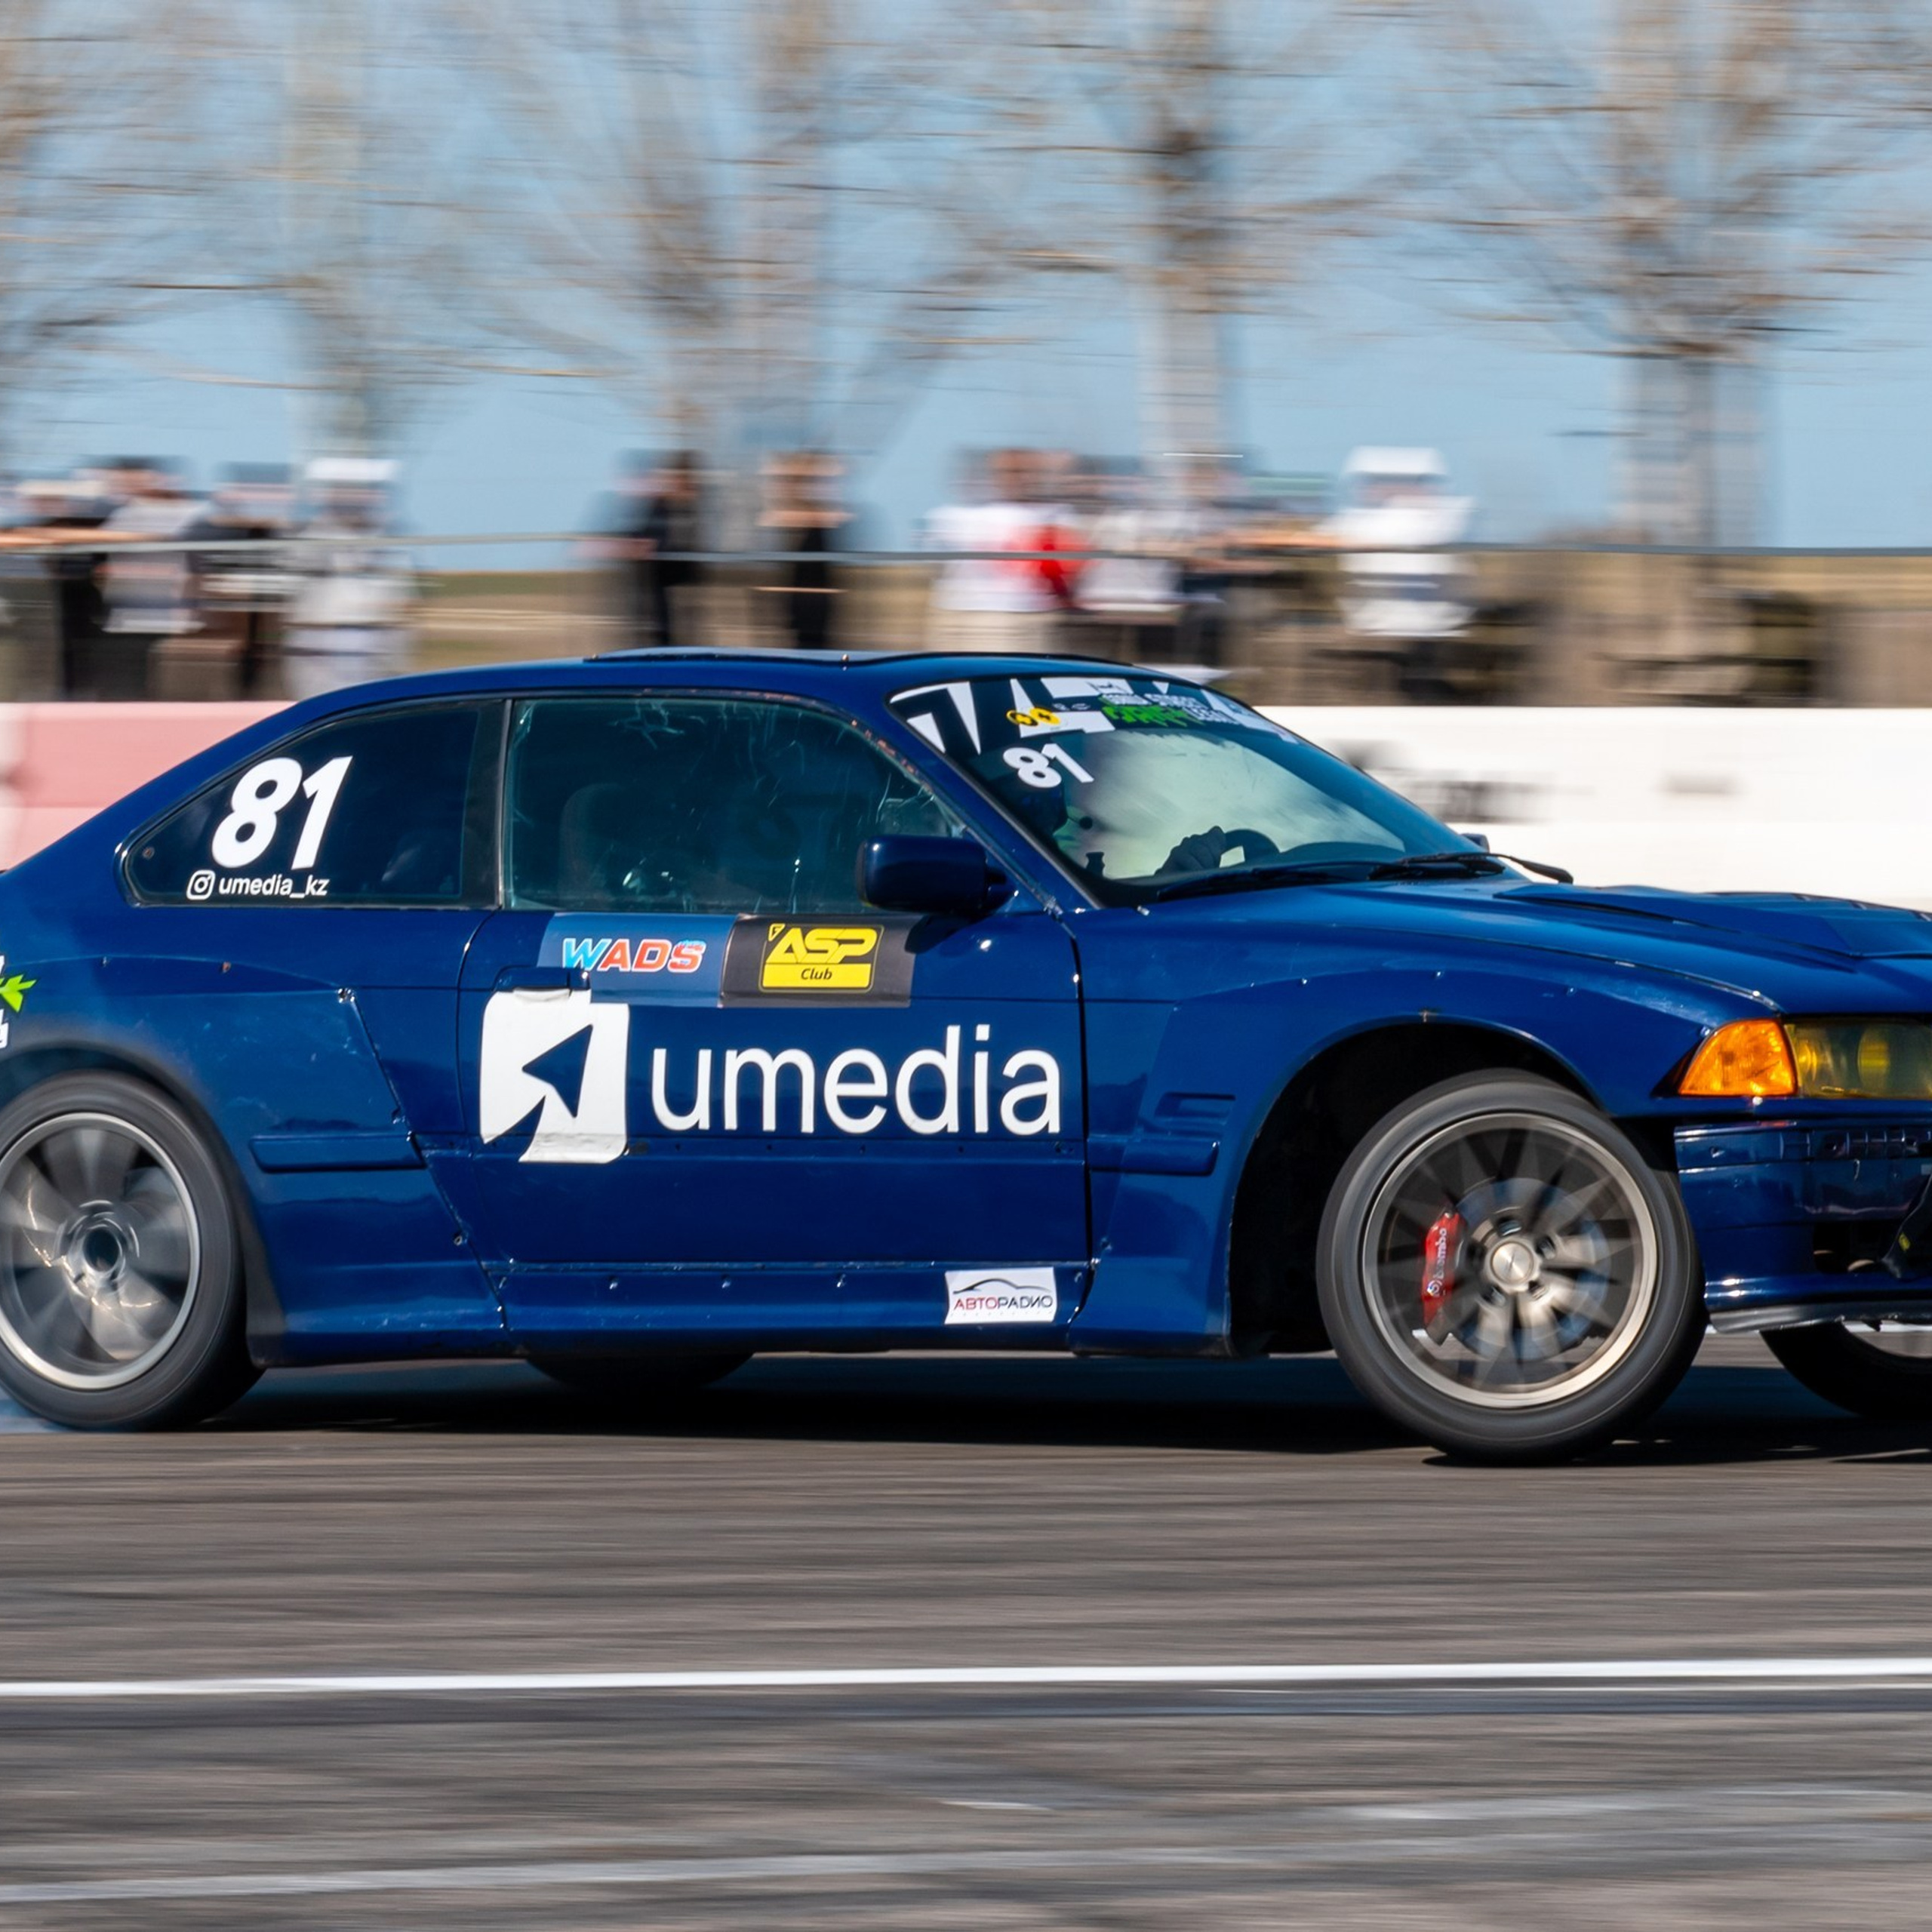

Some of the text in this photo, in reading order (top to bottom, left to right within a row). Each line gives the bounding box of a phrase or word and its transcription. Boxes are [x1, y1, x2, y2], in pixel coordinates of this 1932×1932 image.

[1002, 743, 1094, 789] 81
[211, 755, 353, 870] 81
[219, 874, 329, 898] umedia_kz
[562, 937, 706, 973] WADS
[766, 928, 878, 963] ASP
[801, 968, 833, 980] Club
[651, 1024, 1061, 1136] umedia
[953, 1295, 1054, 1311] АВТОРАДИО
